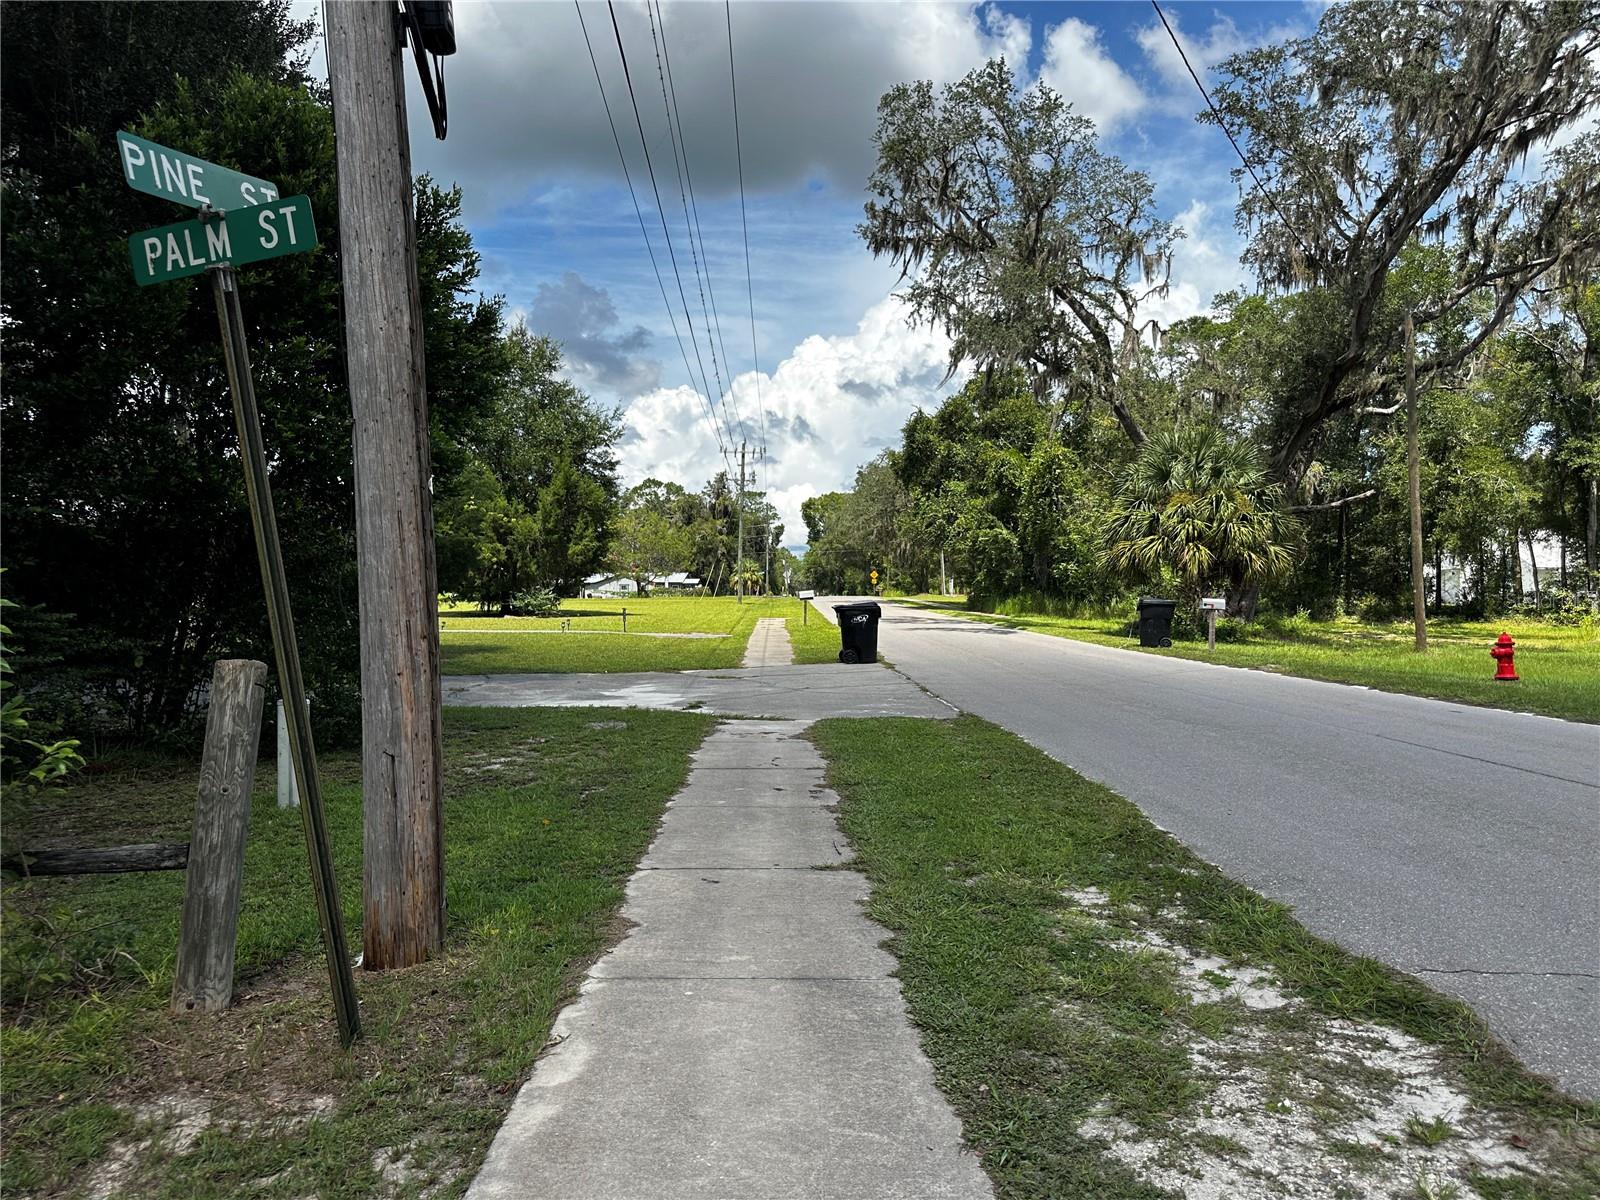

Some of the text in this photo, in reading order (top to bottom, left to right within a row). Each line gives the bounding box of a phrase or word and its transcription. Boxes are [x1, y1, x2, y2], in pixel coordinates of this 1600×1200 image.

[121, 139, 210, 204] PINE
[144, 205, 297, 276] PALM ST
